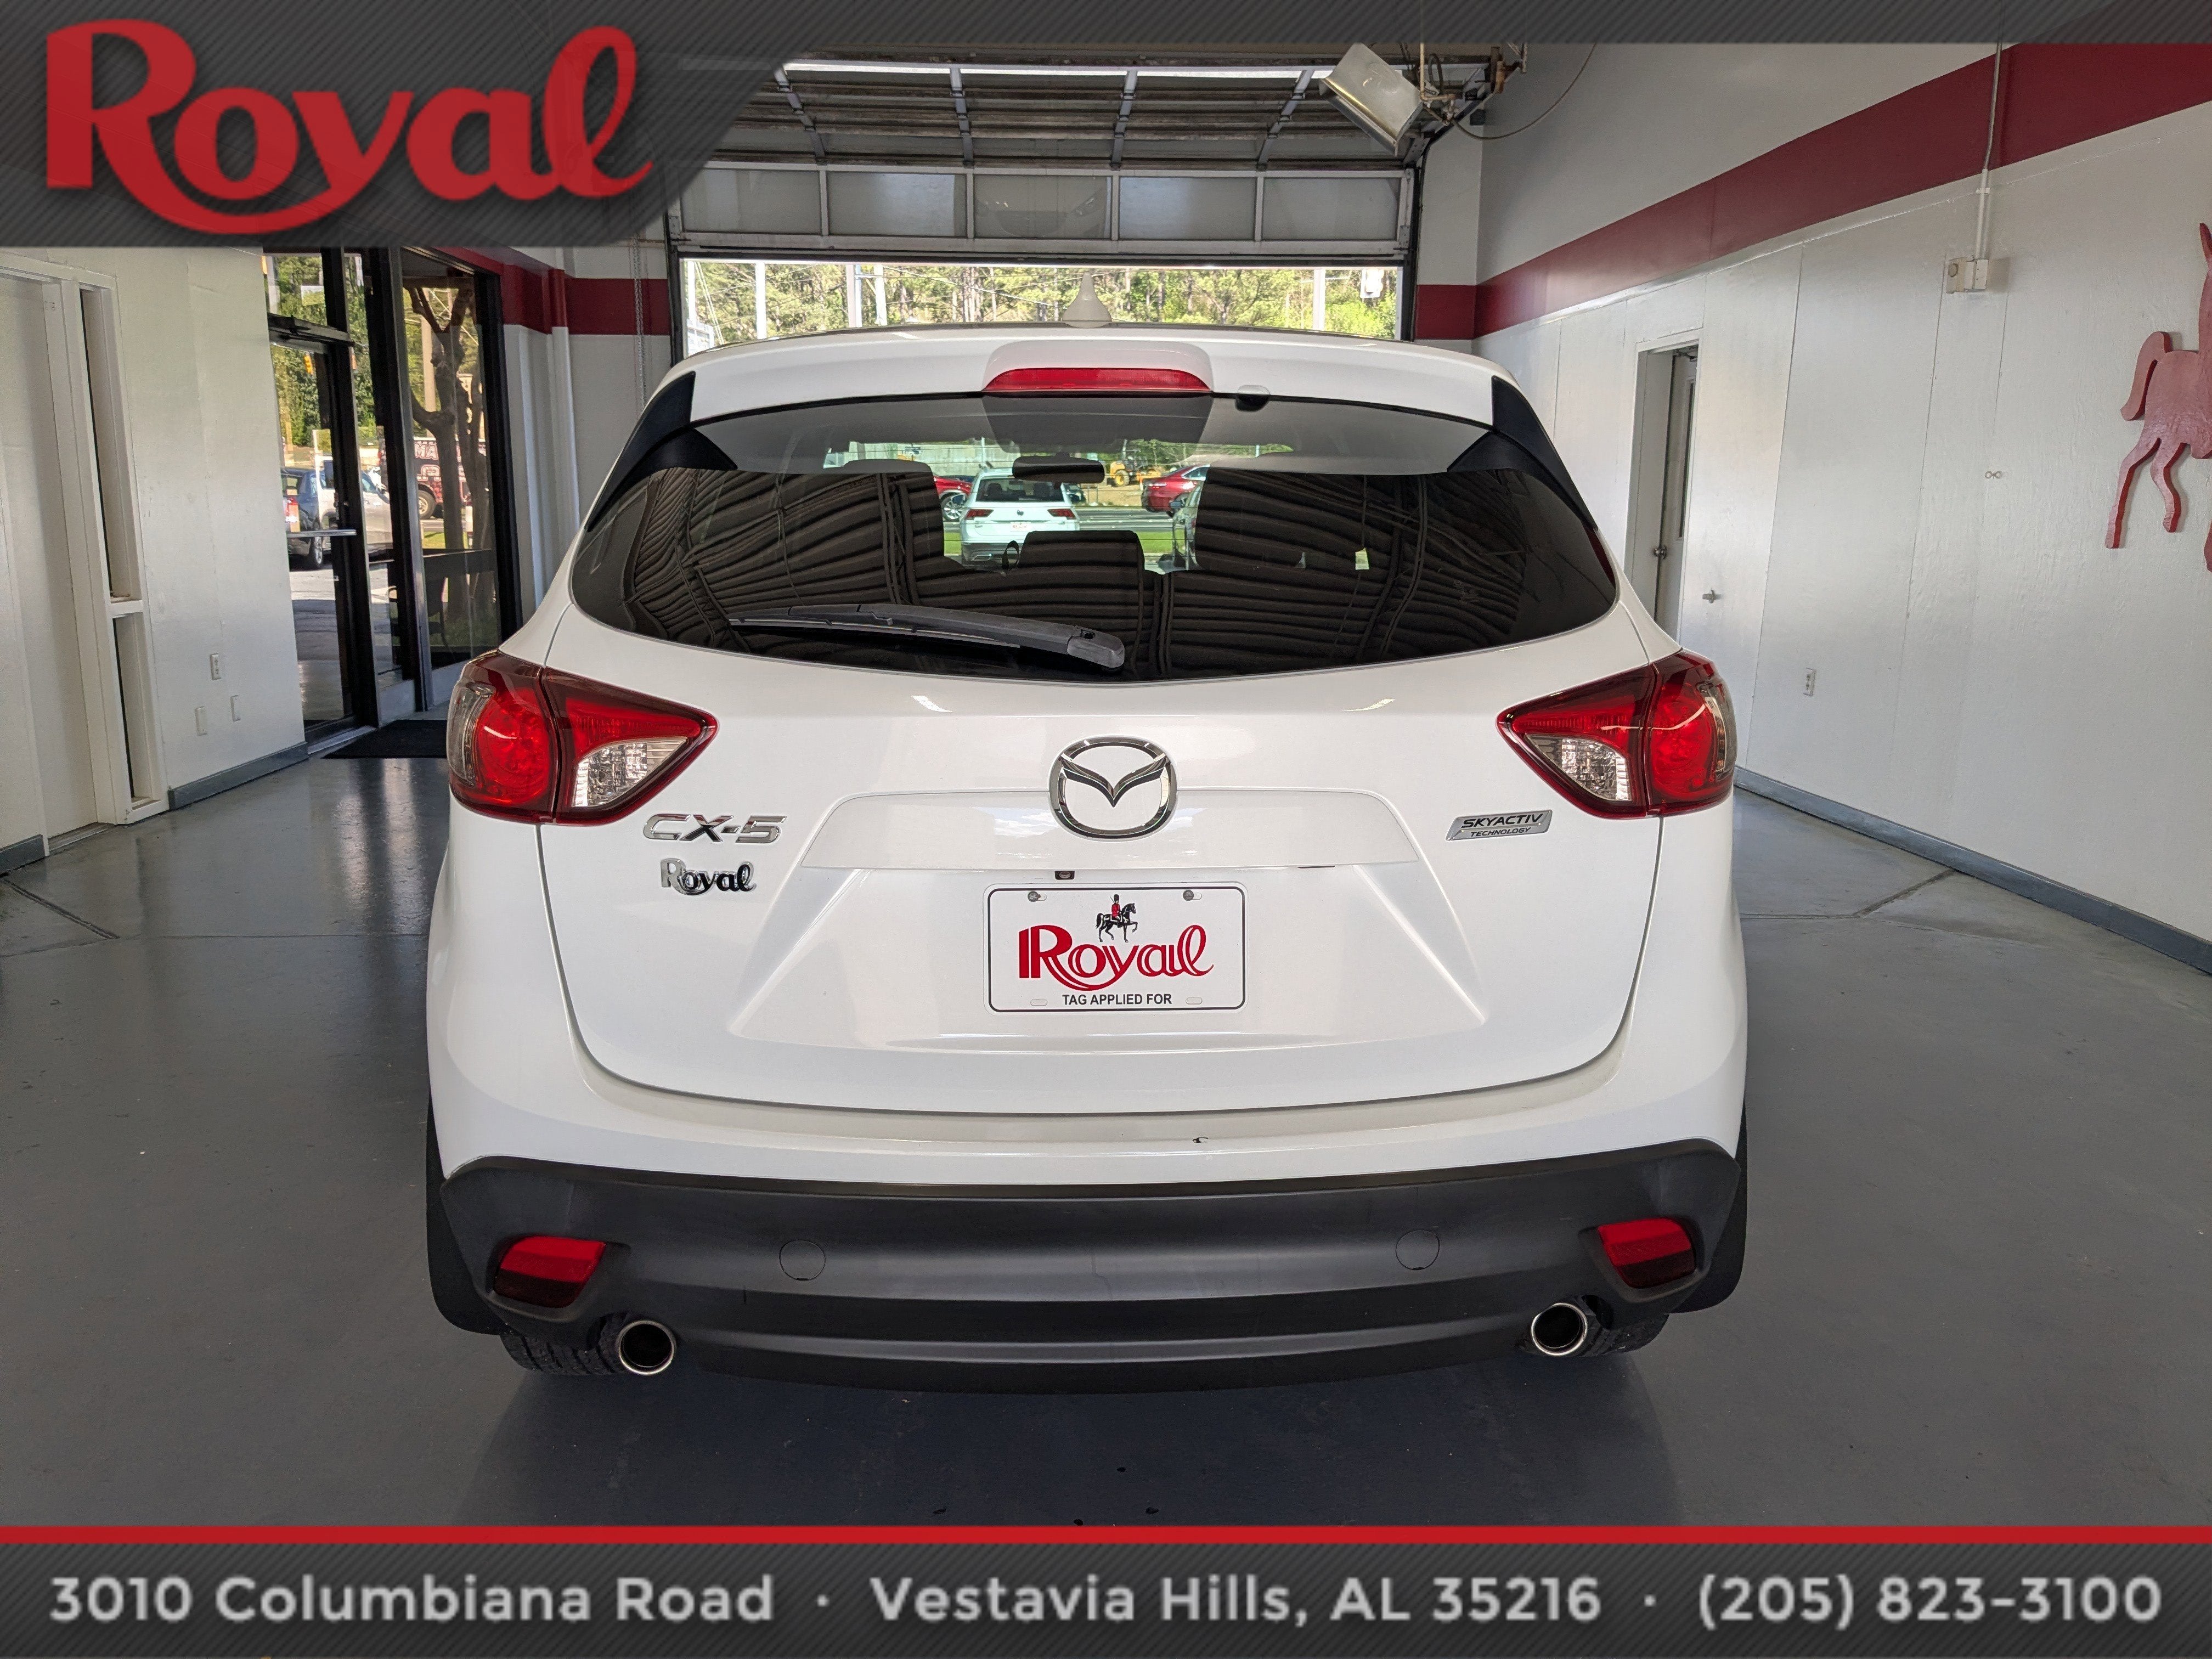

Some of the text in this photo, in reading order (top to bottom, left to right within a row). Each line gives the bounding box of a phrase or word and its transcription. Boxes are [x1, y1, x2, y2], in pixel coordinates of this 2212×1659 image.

[643, 814, 787, 843] CX-5
[1461, 813, 1544, 828] SKYACTIV
[1470, 827, 1532, 837] TECHNOLOGY
[660, 857, 757, 896] Royal
[1019, 924, 1214, 991] Royal
[1062, 993, 1172, 1005] TAG APPLIED FOR
